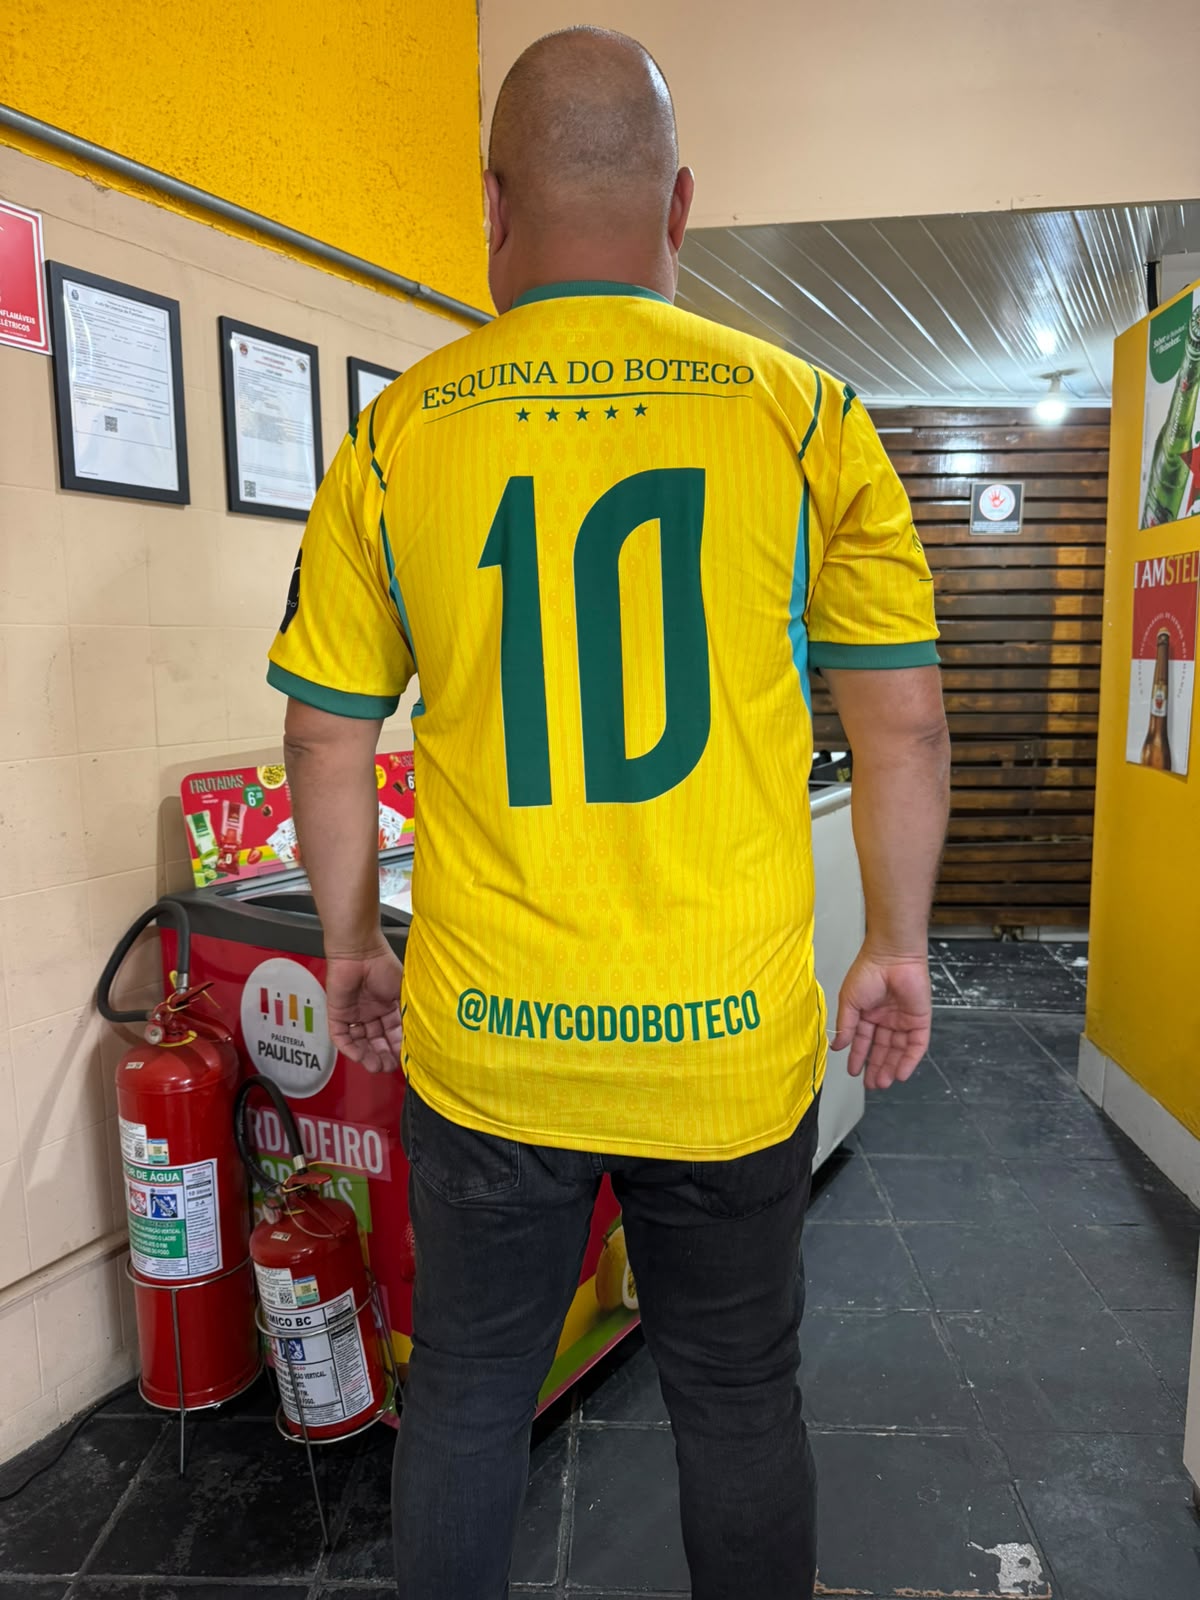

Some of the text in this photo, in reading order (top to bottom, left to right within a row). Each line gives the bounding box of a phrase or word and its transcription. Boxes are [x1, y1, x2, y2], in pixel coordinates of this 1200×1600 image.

[421, 358, 754, 410] ESQUINA DO BOTECO
[477, 467, 712, 807] 10
[188, 774, 244, 794] FRUTADAS
[457, 988, 760, 1042] @MAYCODOBOTECO
[271, 1032, 305, 1048] PALETERIA
[258, 1039, 322, 1072] PAULISTA
[136, 1170, 148, 1180] DE
[150, 1170, 180, 1182] ÁGUA
[295, 1316, 312, 1327] BC
